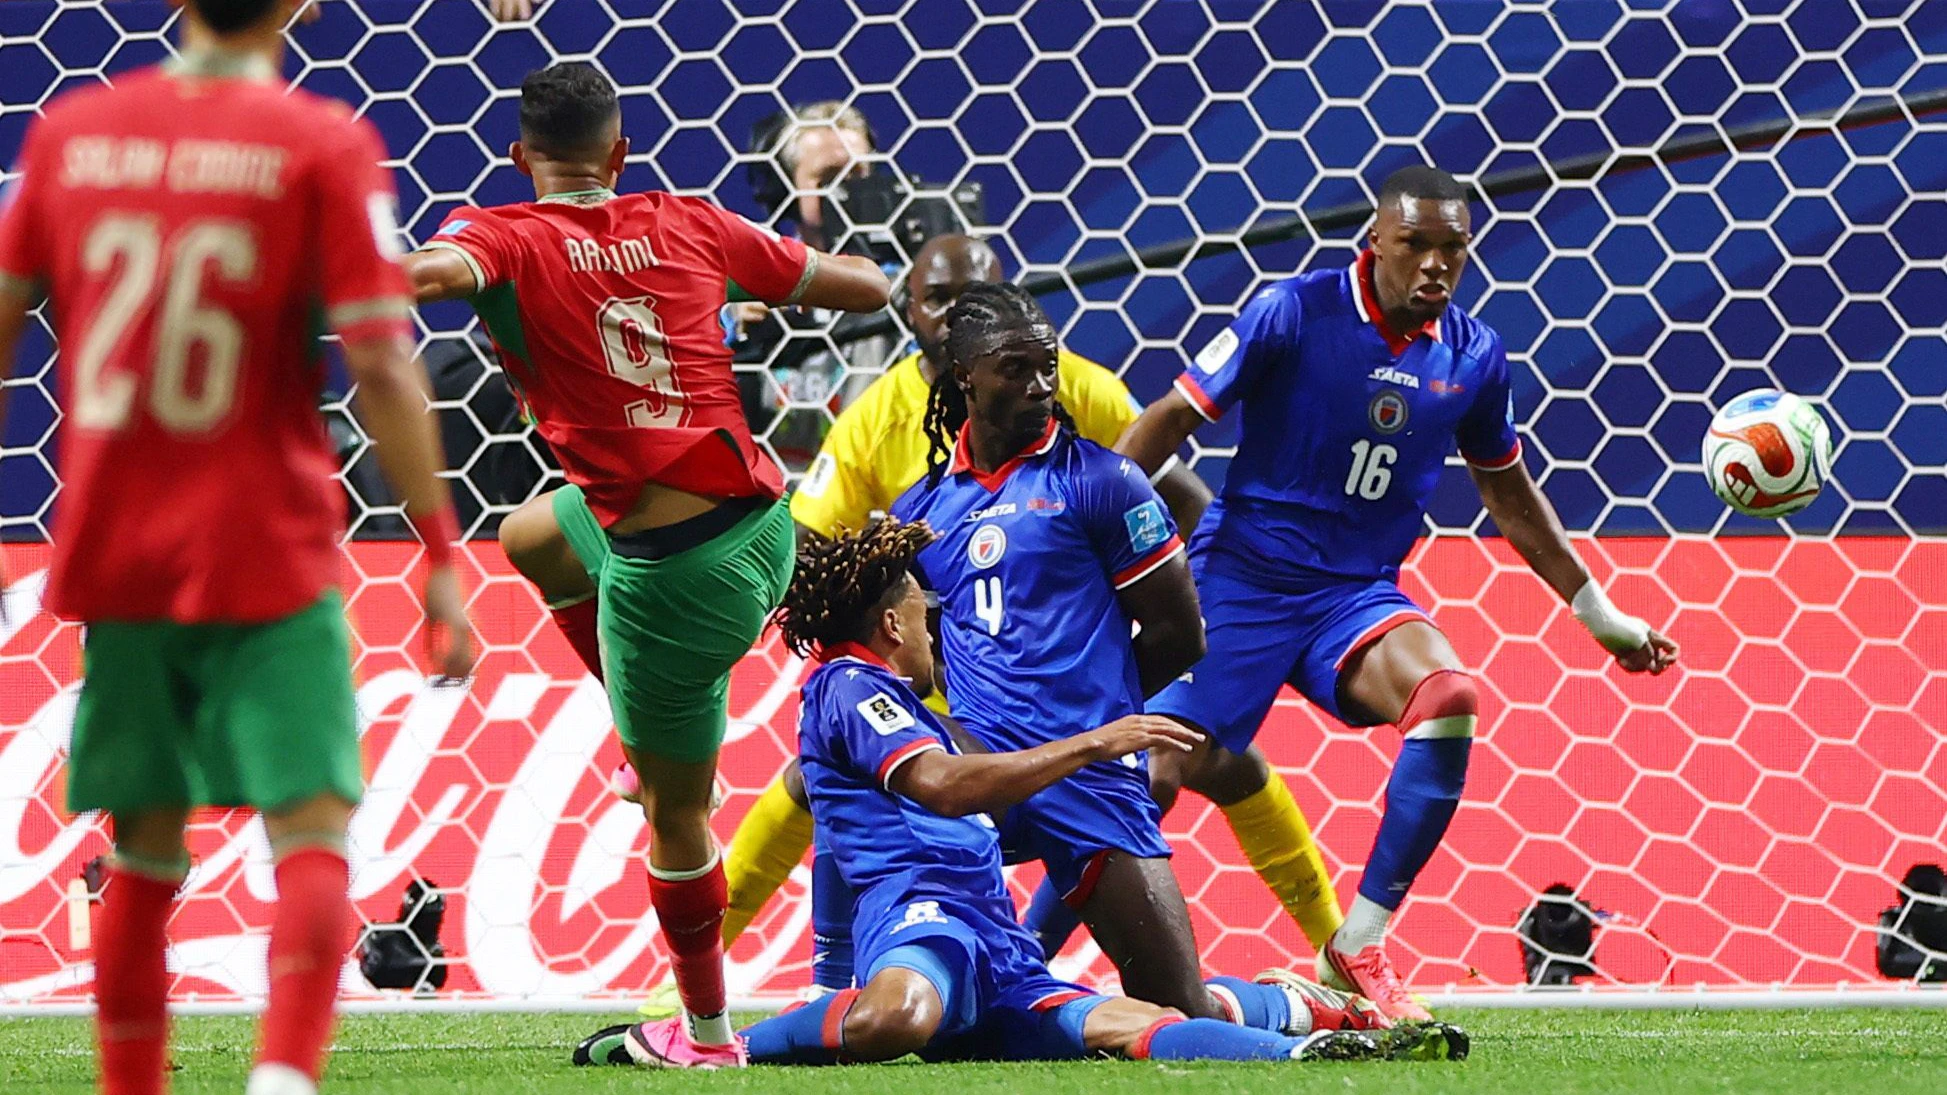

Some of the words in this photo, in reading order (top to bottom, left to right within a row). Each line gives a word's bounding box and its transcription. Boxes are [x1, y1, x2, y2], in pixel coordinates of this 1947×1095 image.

[74, 213, 258, 437] 26
[596, 295, 693, 429] 9
[1345, 438, 1398, 501] 16
[974, 576, 1004, 637] 4
